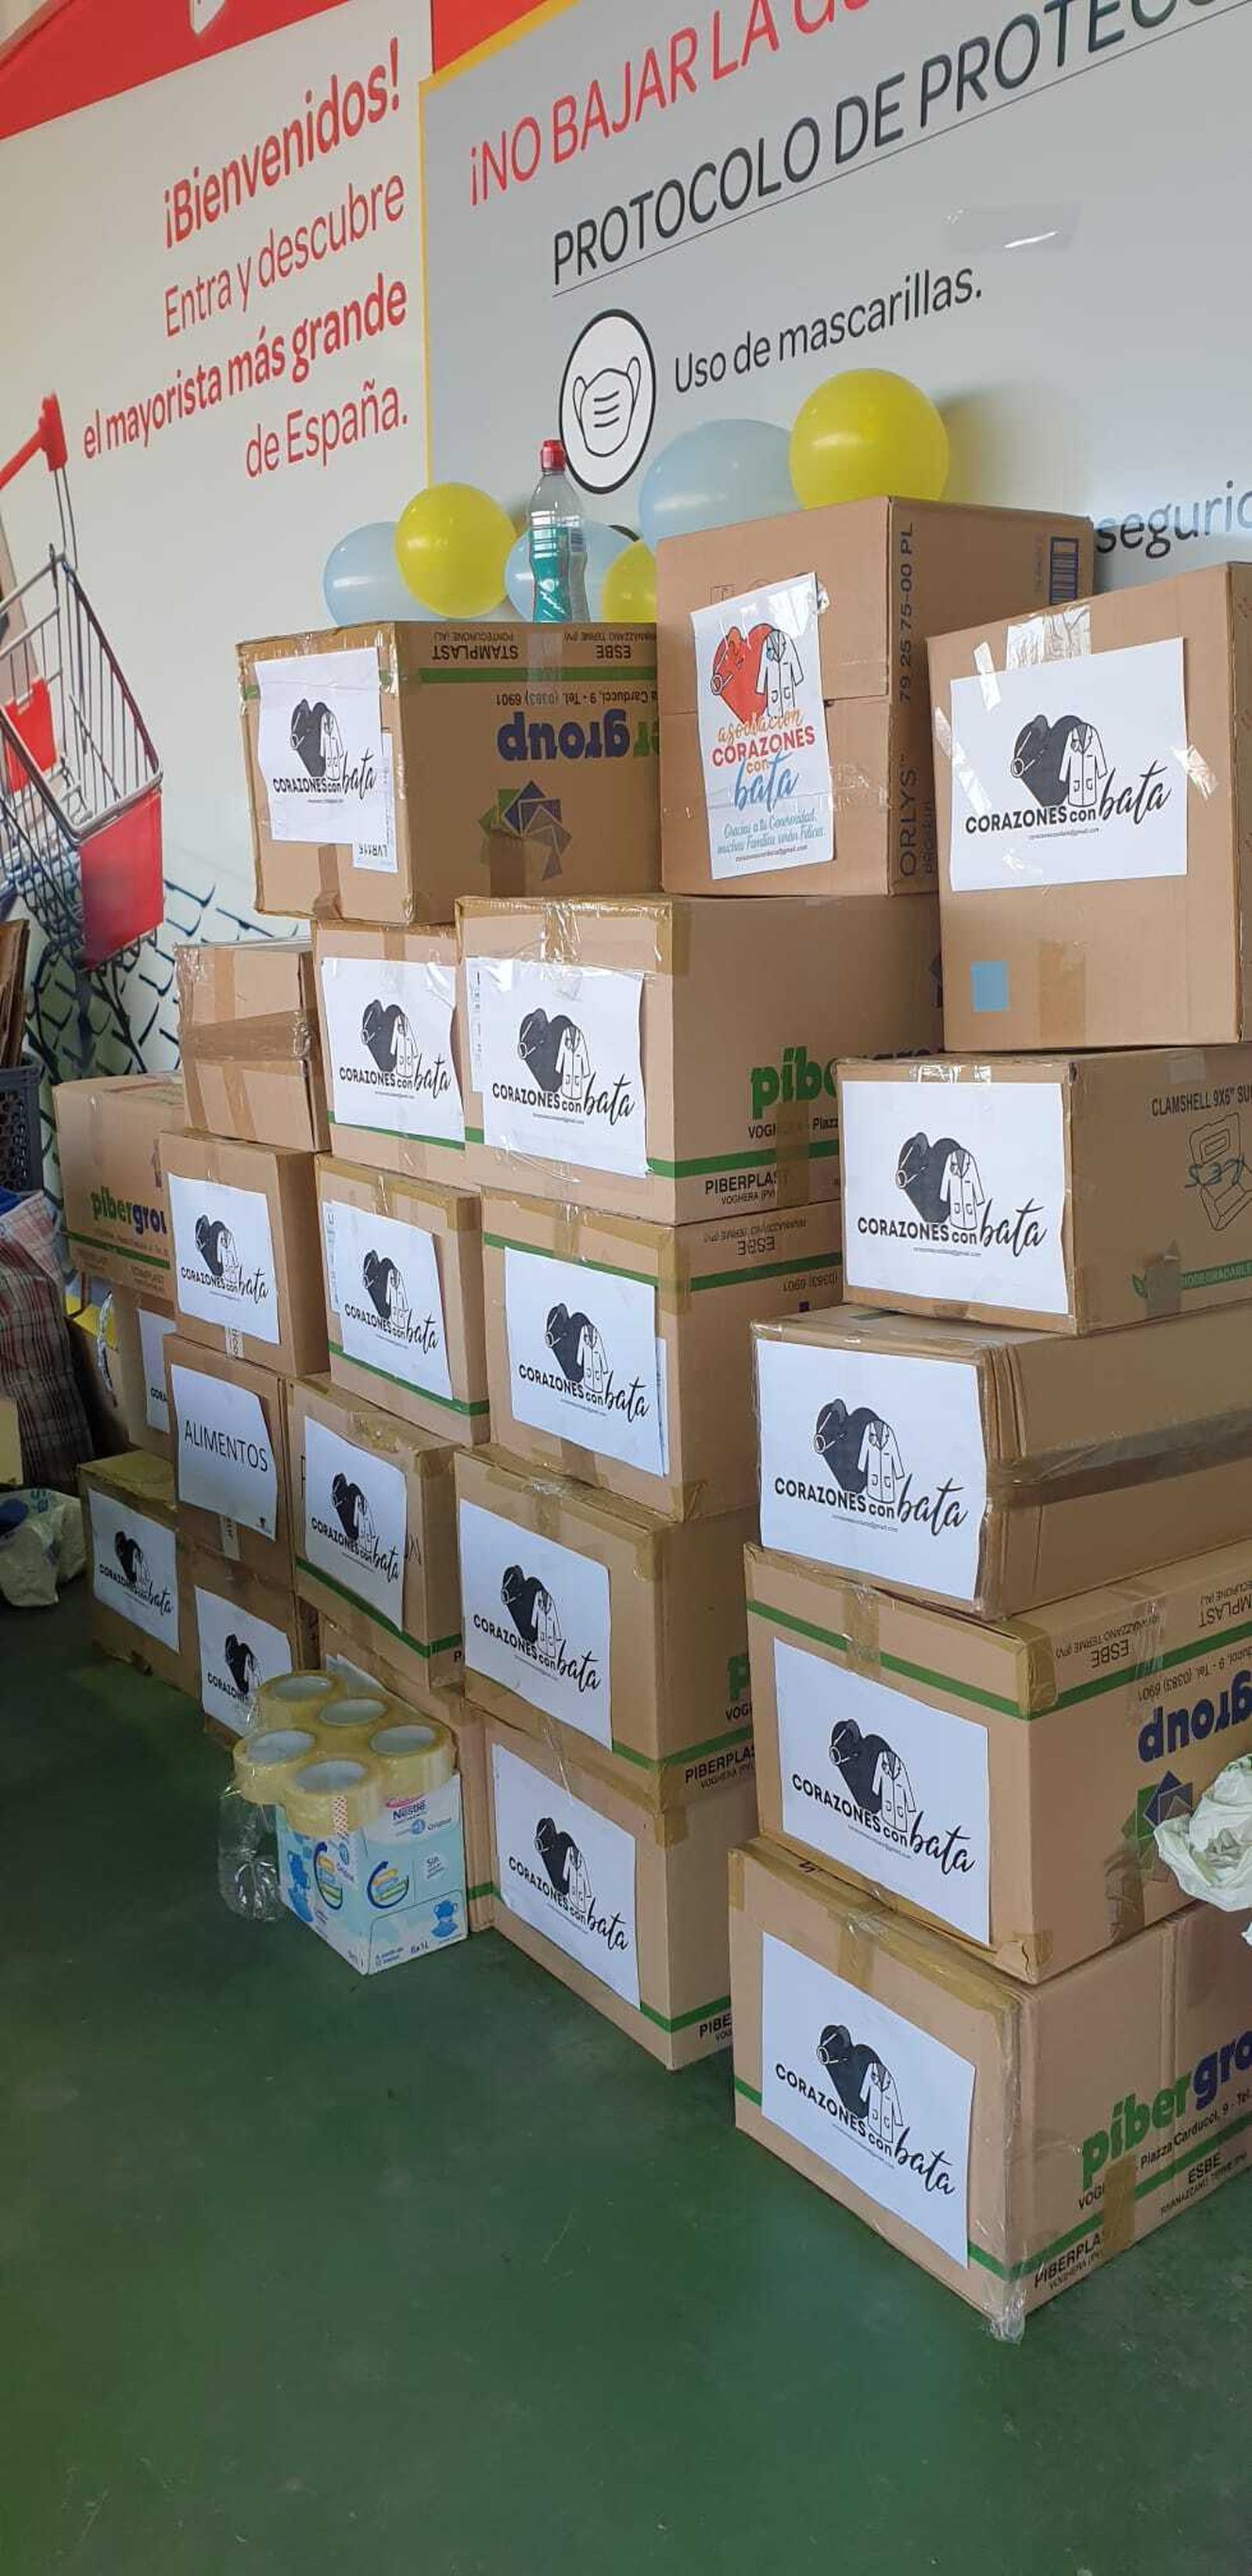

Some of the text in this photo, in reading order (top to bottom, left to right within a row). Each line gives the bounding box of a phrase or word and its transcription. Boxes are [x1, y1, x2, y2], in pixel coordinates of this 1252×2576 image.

[471, 0, 779, 207] ¡NO BAJAR LA
[164, 37, 400, 248] ¡Bienvenidos!
[552, 117, 820, 286] PROTOCOLO
[834, 71, 906, 164] DE
[164, 174, 405, 337] Entra y descubre
[675, 267, 983, 393] Uso de mascarillas.
[84, 272, 407, 459] el mayorista más grande
[246, 377, 408, 477] de España.
[900, 521, 913, 556] PL
[431, 644, 519, 662] STAMPLAST
[595, 644, 632, 661] ESBE
[272, 776, 327, 795] CORAZONES
[340, 748, 376, 800] bata
[712, 726, 815, 768] CORAZONES
[746, 758, 770, 774] con
[733, 750, 800, 812] bata
[966, 759, 1172, 835] CORAZONES con bata
[338, 1067, 396, 1087] CORAZONES
[397, 1074, 413, 1090] con
[413, 1053, 452, 1100] bata
[492, 1082, 561, 1111] CORAZONES
[562, 1096, 583, 1115] con
[583, 1072, 636, 1126] bata
[1152, 1093, 1212, 1118] CLAMSHELL
[1237, 1082, 1252, 1104] SU
[736, 1235, 777, 1256] ESBE
[858, 1216, 950, 1242] CORAZONES
[952, 1229, 977, 1246] con
[978, 1197, 1047, 1257] bata
[180, 1266, 226, 1292] CORAZONES
[238, 1262, 270, 1305] bata
[344, 1302, 391, 1334] CORAZONES
[405, 1306, 440, 1353] bata
[518, 1364, 585, 1401] CORAZONES
[585, 1391, 604, 1406] con
[603, 1370, 651, 1424] bata
[184, 1419, 269, 1475] ALIMENTOS
[774, 1476, 866, 1514] CORAZONES
[868, 1503, 895, 1519] con
[896, 1472, 970, 1537] bata
[311, 1516, 359, 1556] CORAZONES
[372, 1537, 401, 1583] bata
[149, 1579, 174, 1616] bata
[472, 1612, 538, 1662] CORAZONES
[538, 1654, 556, 1671] con
[556, 1637, 601, 1693] bata
[1090, 1638, 1130, 1669] ESBE
[792, 1773, 882, 1835] CORAZONES
[883, 1825, 909, 1848] con
[908, 1809, 977, 1875] bata
[508, 1856, 569, 1912] CORAZONES
[569, 1904, 587, 1926] con
[586, 1897, 630, 1951] bata
[774, 2063, 868, 2139] CORAZONES
[867, 2131, 894, 2160] con
[894, 2126, 956, 2196] bata
[1187, 2152, 1223, 2185] ESBE
